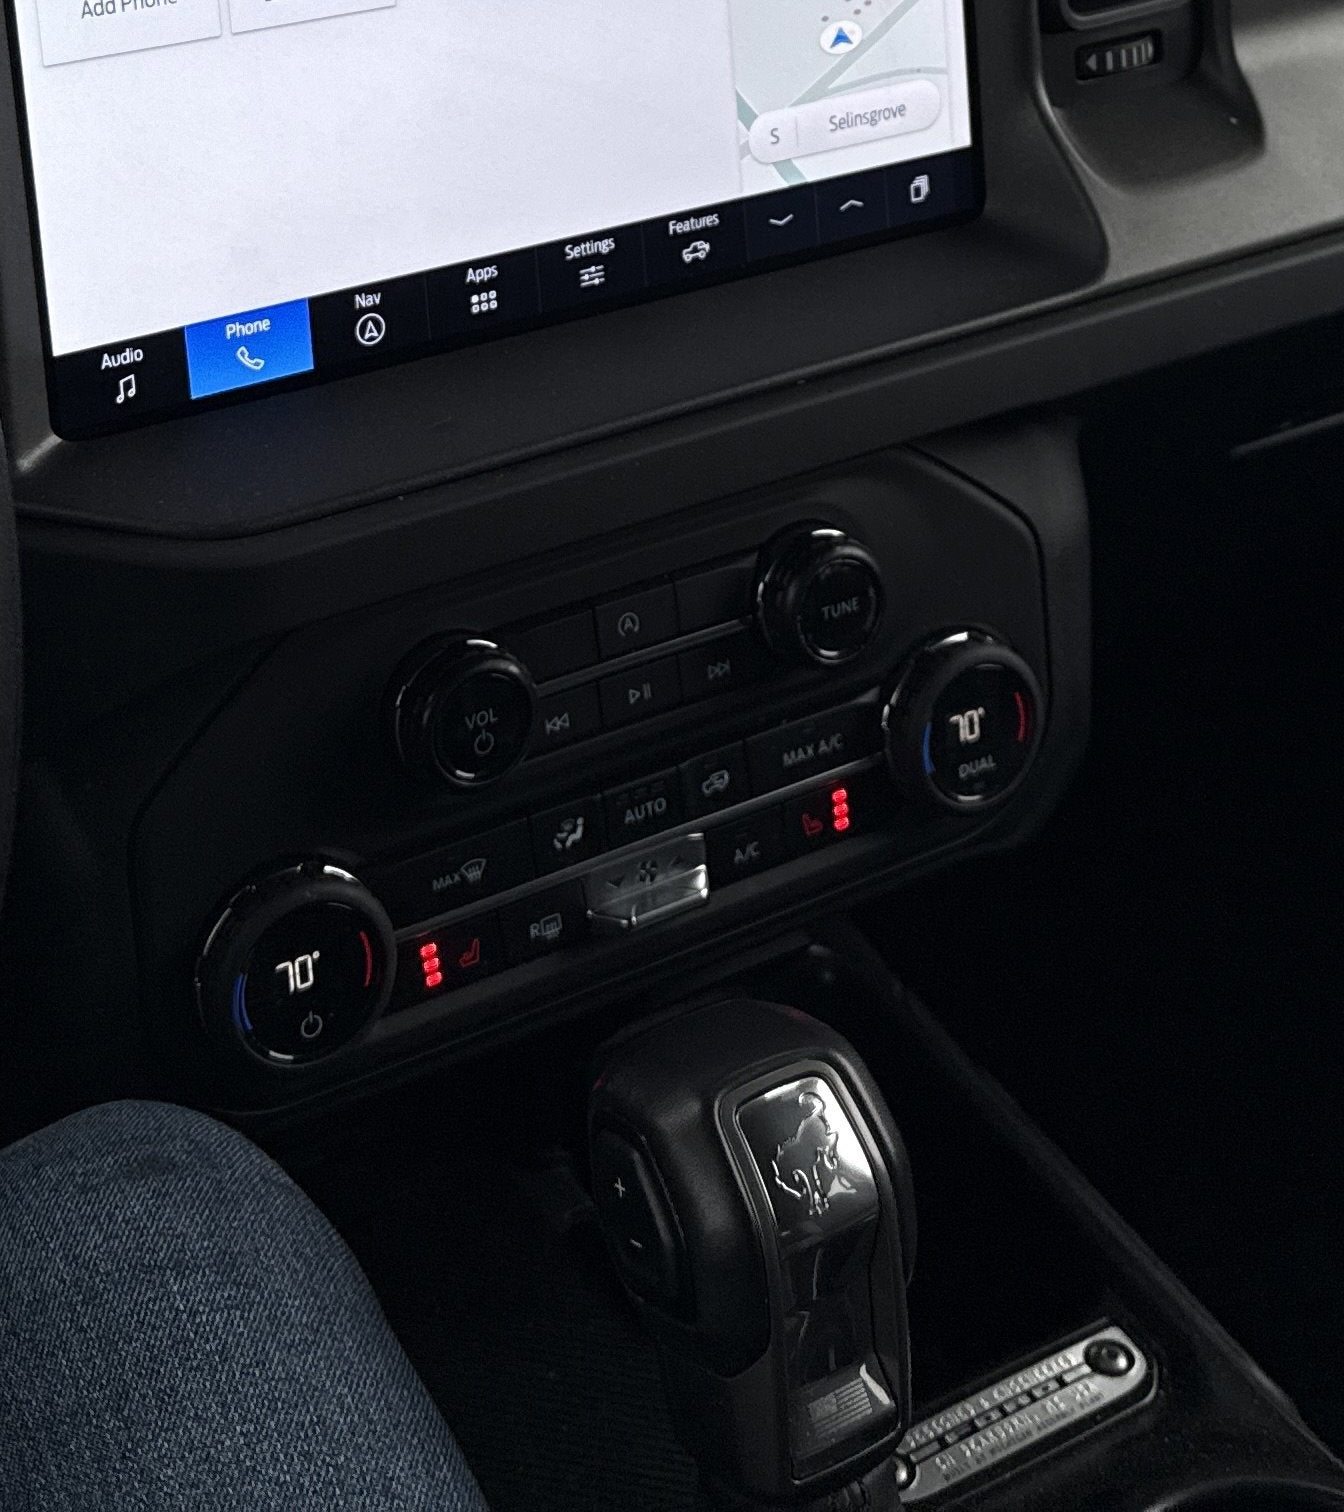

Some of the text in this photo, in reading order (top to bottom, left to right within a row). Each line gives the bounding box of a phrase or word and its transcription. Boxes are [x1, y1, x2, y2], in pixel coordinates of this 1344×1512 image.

[769, 101, 907, 145] S Selinsgrove
[668, 212, 720, 236] Features
[564, 235, 616, 260] Settings
[465, 262, 498, 285] Apps
[354, 290, 382, 309] Nav
[225, 316, 271, 340] Phone
[100, 346, 144, 371] Audio
[820, 596, 861, 621] TUNE
[464, 707, 499, 730] VOL
[782, 733, 844, 768] MAX A/C
[958, 755, 997, 779] DUAL
[624, 796, 668, 825] AUTO
[734, 840, 761, 864] A/C
[432, 870, 462, 892] MAX
